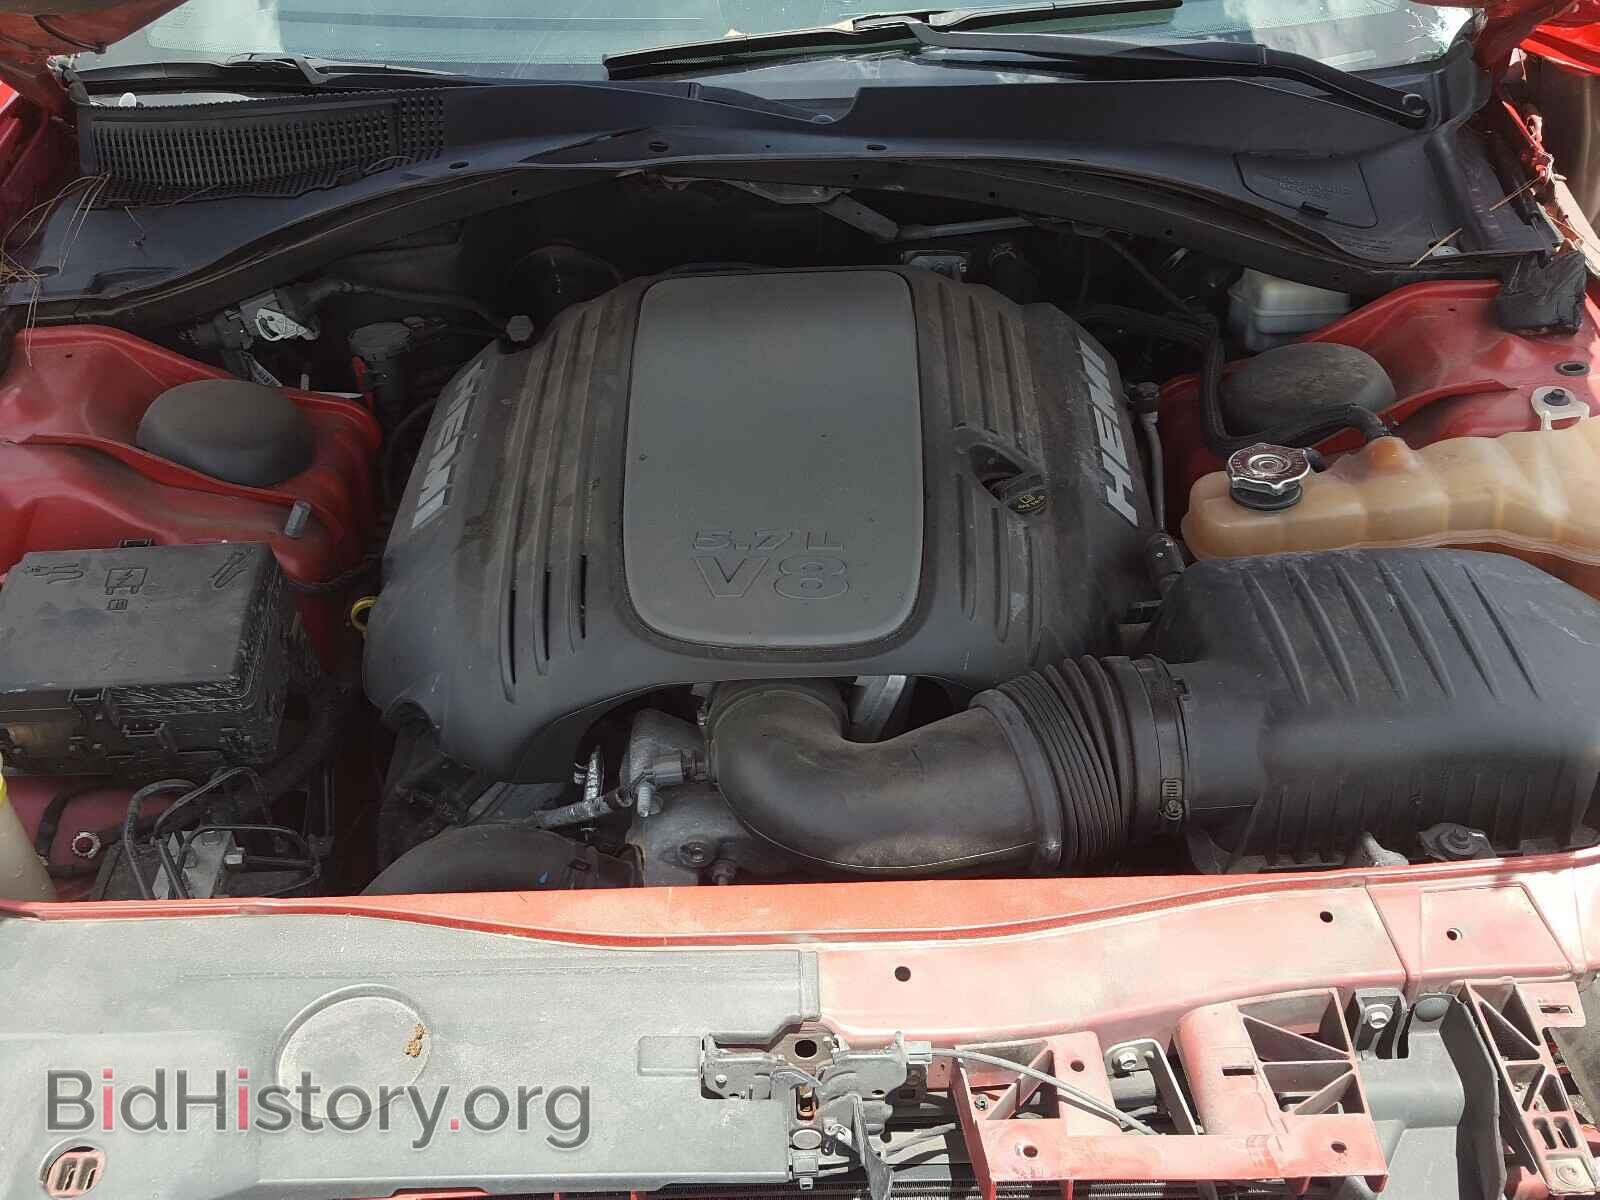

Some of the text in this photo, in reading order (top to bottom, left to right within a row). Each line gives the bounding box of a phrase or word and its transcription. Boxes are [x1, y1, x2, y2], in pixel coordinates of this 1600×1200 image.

[412, 359, 482, 528] HEMI
[1078, 336, 1138, 527] HEMI
[692, 556, 849, 600] V8
